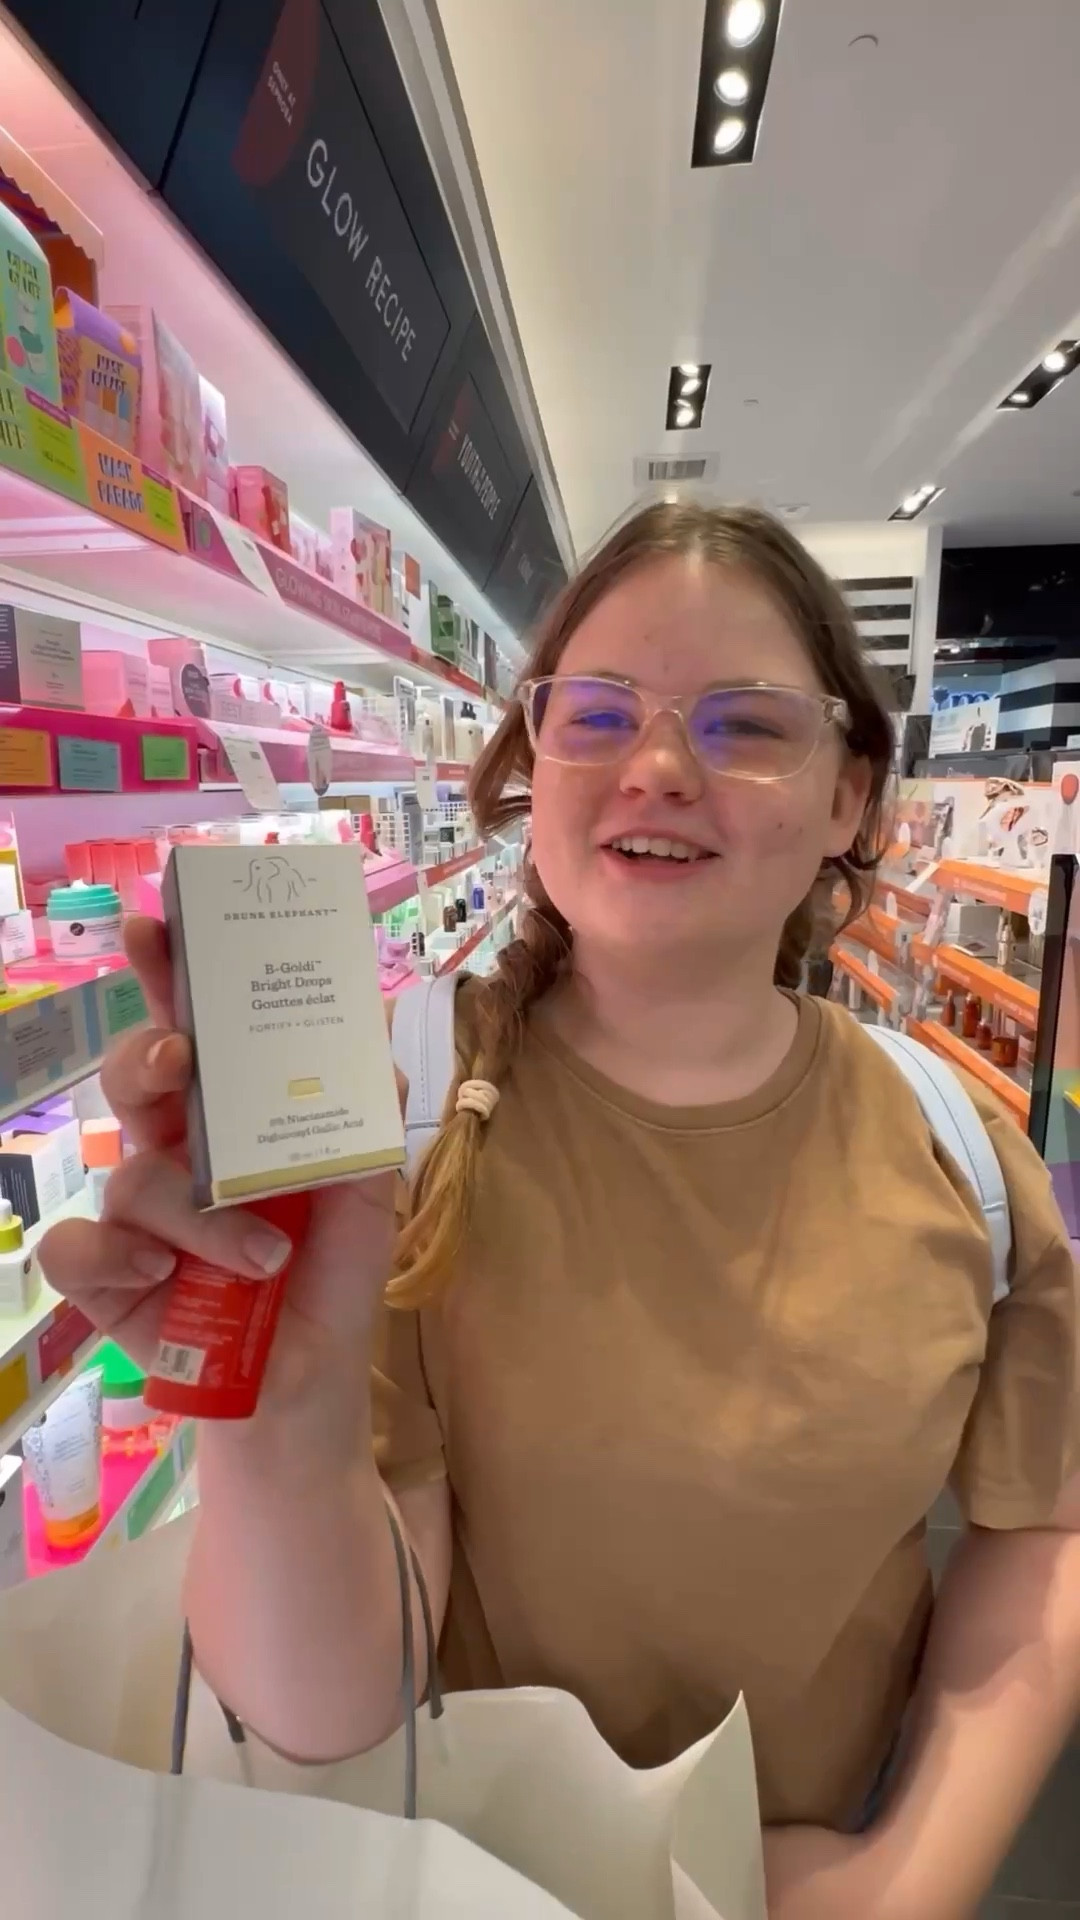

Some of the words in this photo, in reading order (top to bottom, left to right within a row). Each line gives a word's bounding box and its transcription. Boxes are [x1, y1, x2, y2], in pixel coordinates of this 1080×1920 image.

[307, 139, 368, 262] GLOW
[365, 256, 417, 361] RECIPE
[223, 911, 265, 921] DRUNK
[250, 979, 292, 993] Bright
[294, 976, 332, 988] Drops
[251, 998, 304, 1010] Gouttes
[305, 993, 336, 1005] éclat
[249, 1021, 291, 1032] FORTIFY
[303, 1016, 344, 1028] GLISTEN
